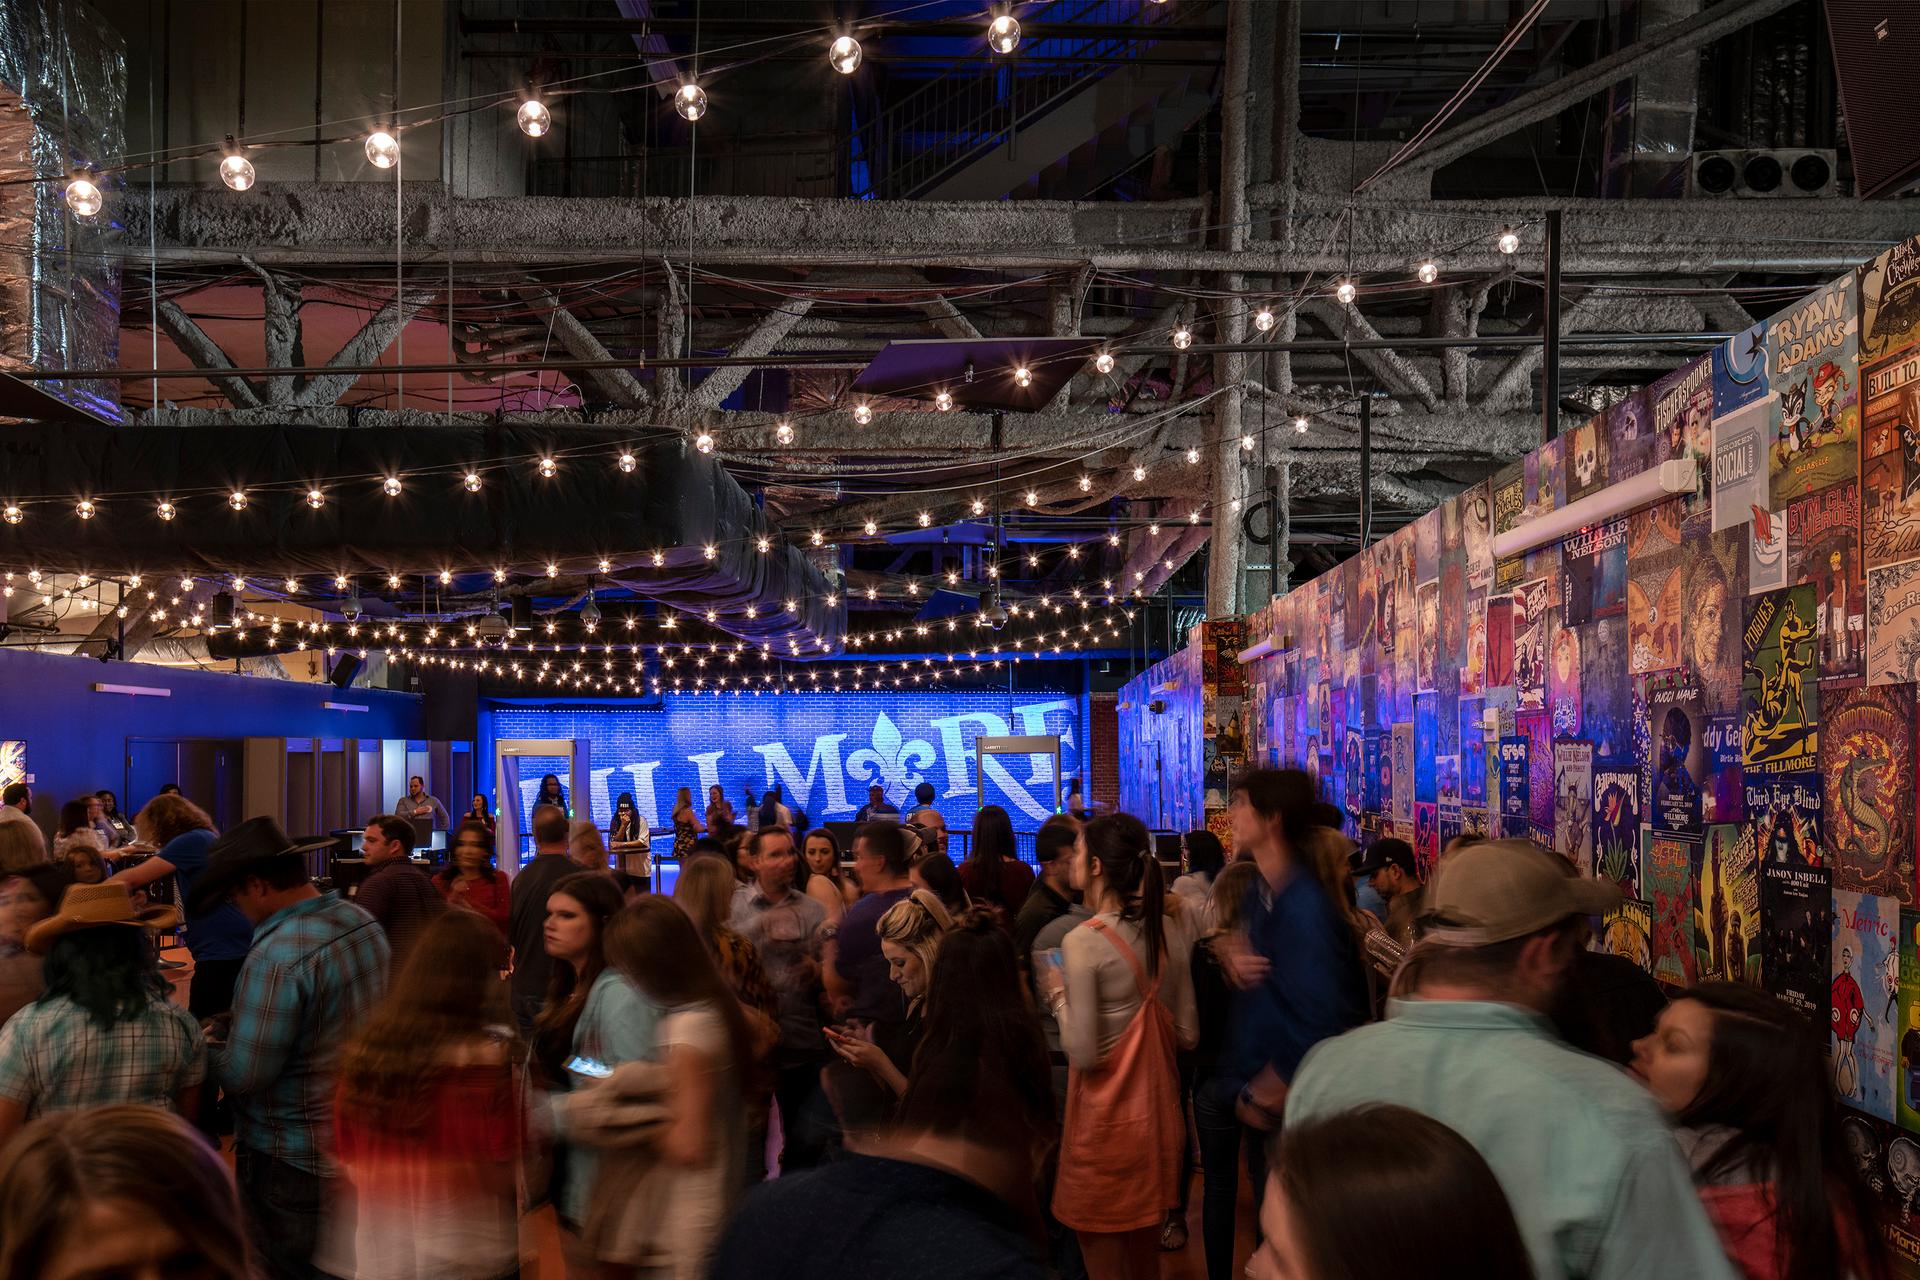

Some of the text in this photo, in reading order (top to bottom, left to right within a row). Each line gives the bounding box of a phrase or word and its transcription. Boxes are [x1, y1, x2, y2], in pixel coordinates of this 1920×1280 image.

[1775, 290, 1847, 349] RYAN
[1776, 320, 1846, 374] ADAMS
[1869, 367, 1900, 397] BUILT
[1902, 360, 1918, 382] TO
[1716, 446, 1749, 486] SOCIAL
[1788, 485, 1858, 536] GYM CLA
[1563, 518, 1628, 552] WILLIE
[1571, 533, 1623, 559] NELSON
[1655, 688, 1699, 705] GUCCI MANE
[1765, 755, 1817, 774] FILLMORE
[1746, 784, 1821, 810] Third Eye Blind
[1209, 819, 1233, 833] POWE
[1767, 868, 1827, 885] JASON ISBELL
[1841, 908, 1889, 937] Metric
[1786, 989, 1806, 1001] FRIDAY
[1890, 1226, 1920, 1256] Marti
